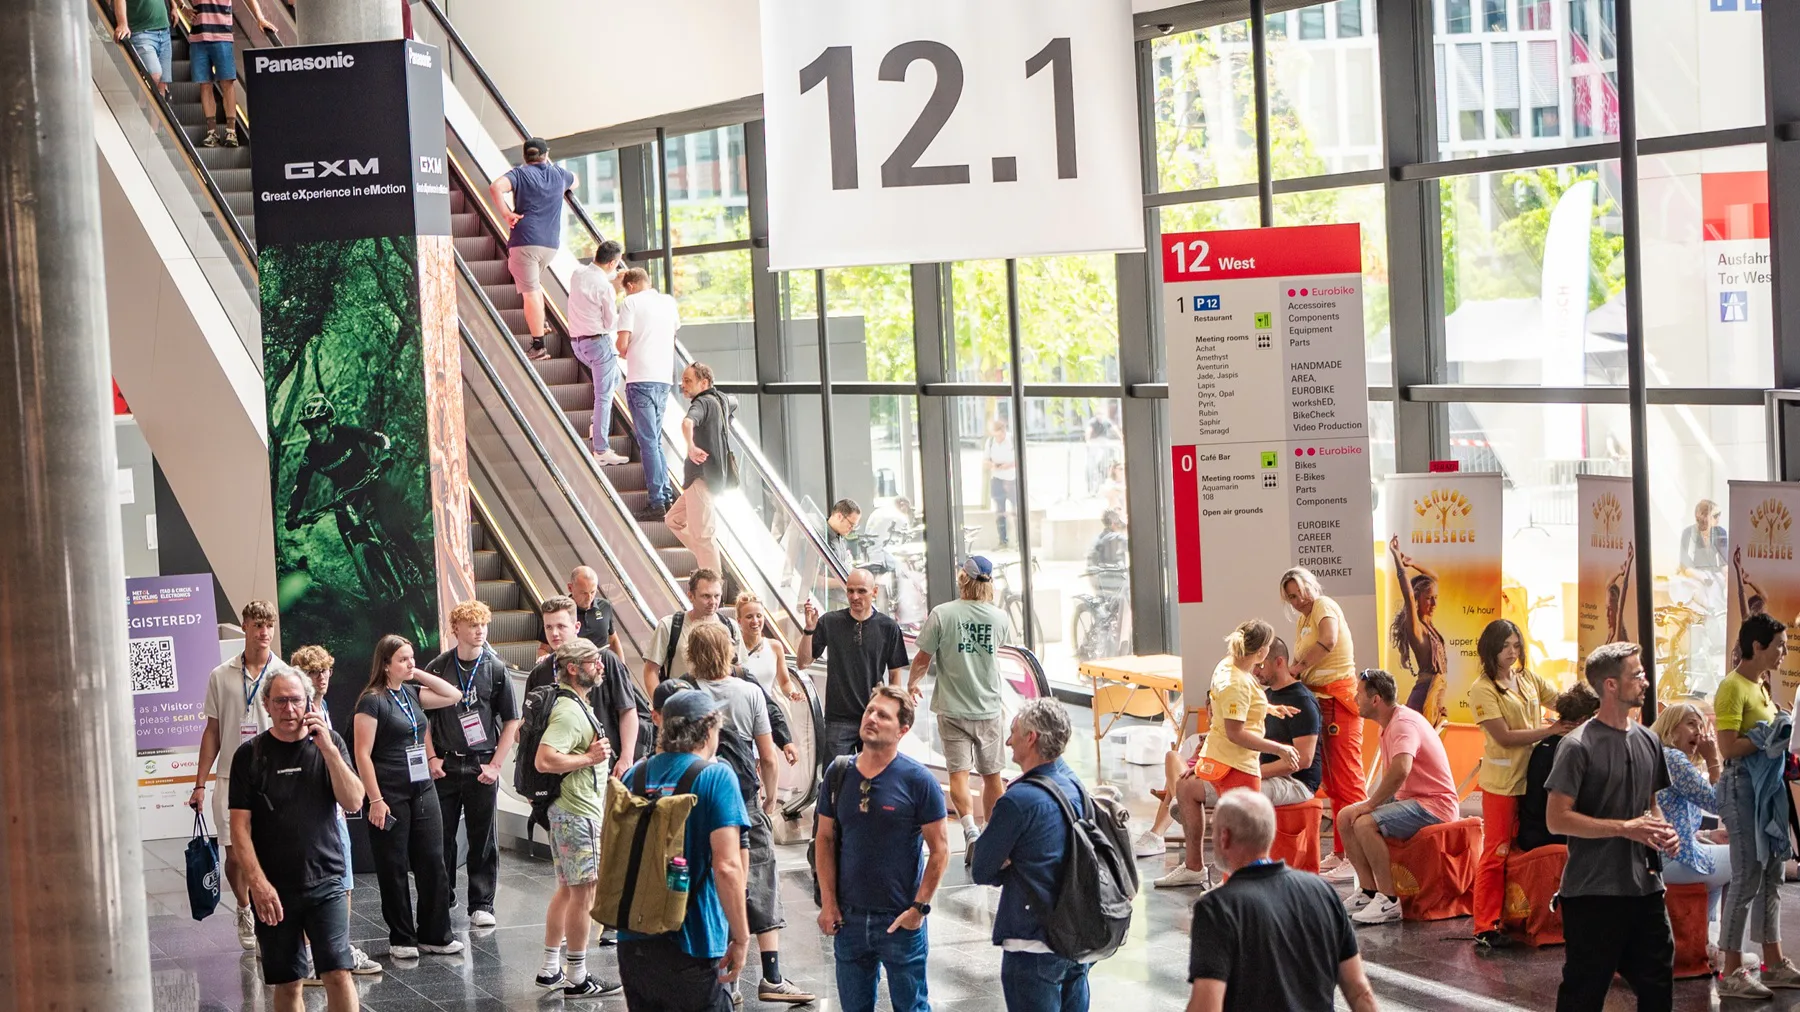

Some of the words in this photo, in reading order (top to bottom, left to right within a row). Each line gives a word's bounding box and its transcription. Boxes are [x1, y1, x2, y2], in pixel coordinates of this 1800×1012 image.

[255, 52, 354, 73] Panasonic
[799, 37, 1077, 190] 12.1
[284, 157, 379, 179] GXM
[419, 156, 442, 175] GXM
[261, 190, 290, 201] Great
[292, 188, 350, 201] eXperience
[353, 187, 362, 196] in
[363, 183, 406, 195] eMotion
[1171, 240, 1211, 274] 12
[1218, 257, 1256, 270] West
[1718, 252, 1770, 265] Ausfahr
[1718, 272, 1739, 284] Tor
[1743, 271, 1772, 283] Wes
[1312, 286, 1354, 296] Eurobike
[1177, 296, 1184, 313] 1
[1288, 301, 1336, 310] Accessoires
[1288, 313, 1340, 323] Components
[1290, 326, 1333, 335] Equipment
[1290, 339, 1310, 347] Parts
[1291, 360, 1342, 370] HANDMADE
[1198, 382, 1215, 390] Lapis
[1292, 385, 1335, 395] EUROBIKE
[1219, 390, 1234, 398] Opal
[1293, 410, 1335, 419] BikeCheck
[1293, 423, 1316, 431] Video
[1318, 421, 1362, 431] Production
[1319, 447, 1362, 456] Eurobike
[1181, 454, 1193, 472] 0
[1295, 461, 1316, 470] Bikes
[1295, 473, 1325, 481] E-Bikes
[1202, 484, 1239, 492] Aquamarin
[1296, 486, 1316, 494] Parts
[1296, 497, 1347, 507] Components
[1202, 509, 1221, 517] Open
[1234, 507, 1263, 516] grounds
[1297, 520, 1340, 530] EUROBIKE
[1298, 533, 1332, 541] CAREER
[1411, 530, 1476, 544] MASSAGE
[1298, 545, 1334, 554] CENTER,
[1747, 543, 1793, 560] MASSAGE
[1299, 556, 1342, 566] EUROBIKE
[1310, 568, 1352, 577] BMARKET
[1463, 606, 1475, 615] 1/4
[1477, 606, 1495, 614] hour
[127, 613, 202, 628] EGISTERED?
[140, 706, 149, 714] as
[161, 702, 193, 711] Visitor
[140, 715, 170, 726] please
[173, 714, 195, 722] scan
[154, 727, 164, 735] to
